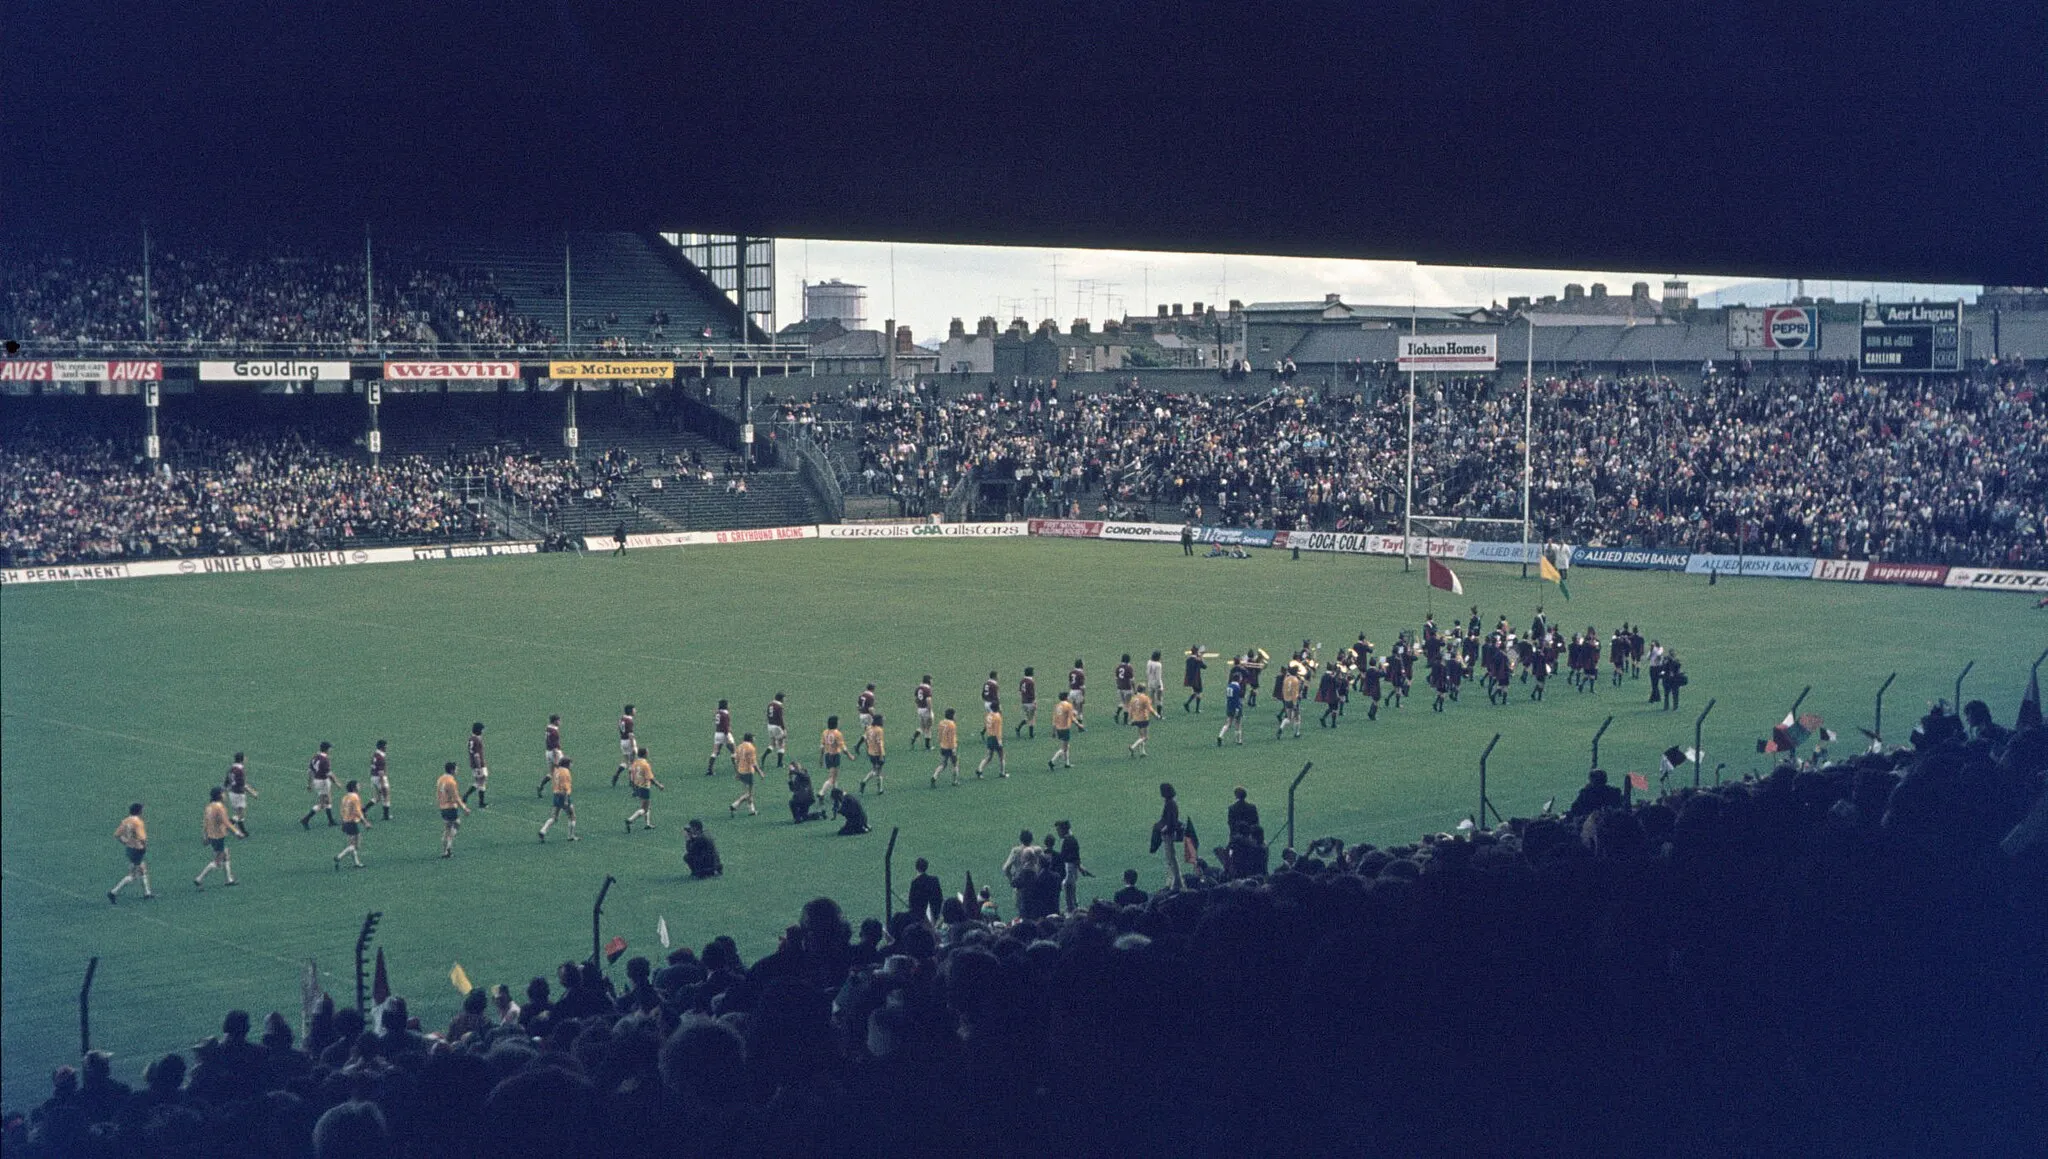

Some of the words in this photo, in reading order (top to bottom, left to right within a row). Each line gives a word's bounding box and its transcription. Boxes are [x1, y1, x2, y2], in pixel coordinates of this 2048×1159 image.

[1888, 307, 1911, 320] Aer
[1912, 306, 1955, 322] Lingus
[1772, 324, 1808, 334] PEPSI
[0, 361, 47, 380] AVIS
[112, 361, 157, 380] AVIS
[233, 361, 320, 378] Goulding
[392, 362, 512, 377] wavin
[581, 364, 669, 376] McInerney
[148, 384, 156, 404] F
[371, 382, 378, 402] E
[717, 531, 727, 543] GO
[731, 530, 773, 542] GREYHOUND
[777, 528, 803, 540] RACING
[911, 525, 943, 535] GAA
[1105, 525, 1151, 536] CONDOR
[1308, 533, 1367, 550] COCA-COLA
[1382, 539, 1404, 550] Tayt
[416, 549, 446, 560] THE
[451, 547, 487, 558] IRISH
[491, 544, 538, 555] PRESS
[1479, 547, 1511, 557] ALLIED
[1584, 550, 1621, 563] ALLIED
[1622, 552, 1650, 564] IRISH
[1650, 553, 1687, 566] BANKS
[203, 556, 261, 573] UNIFLO
[291, 552, 346, 568] UNIFLO
[1702, 559, 1740, 570] ALLIED
[1740, 560, 1771, 571] IRISH
[1772, 561, 1809, 573] BANKS
[1820, 560, 1861, 579] Erin
[1873, 567, 1939, 580] supersoups
[1974, 573, 2048, 587] DUNL
[1119, 668, 1125, 679] 2
[861, 697, 866, 708] 7
[917, 689, 923, 701] 6
